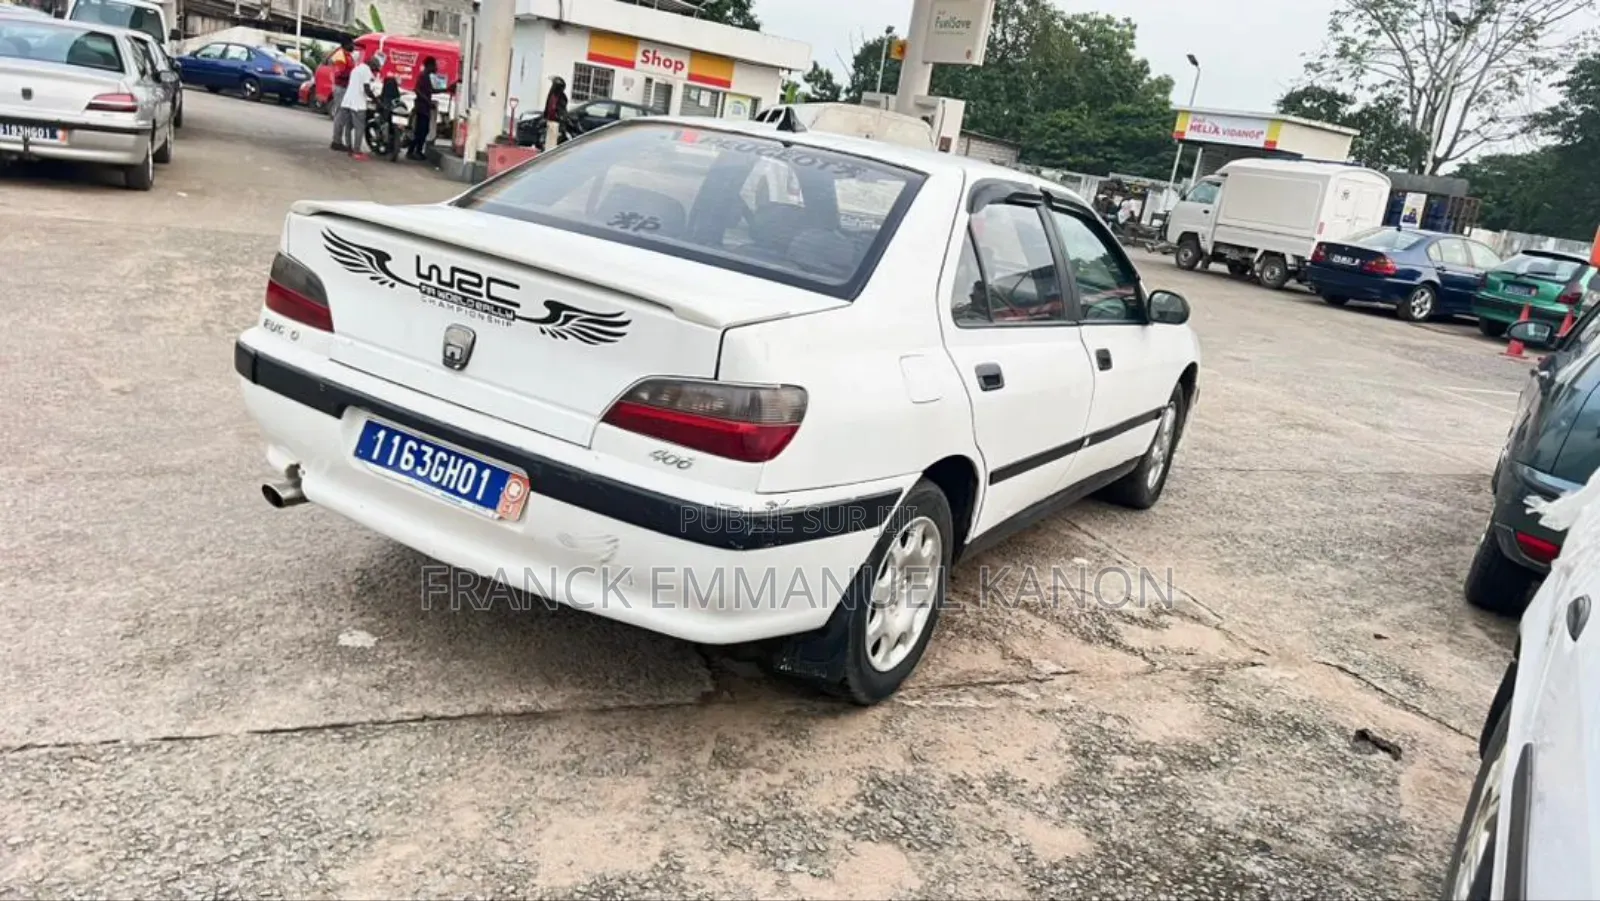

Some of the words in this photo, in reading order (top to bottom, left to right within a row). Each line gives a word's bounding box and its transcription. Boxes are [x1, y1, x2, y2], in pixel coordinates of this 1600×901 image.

[640, 49, 685, 74] Shop
[1189, 123, 1220, 135] HELIX
[415, 254, 521, 309] WRC
[420, 295, 513, 327] CHAMPIONSHIP
[371, 429, 492, 501] 1163GH01
[649, 449, 694, 469] 406
